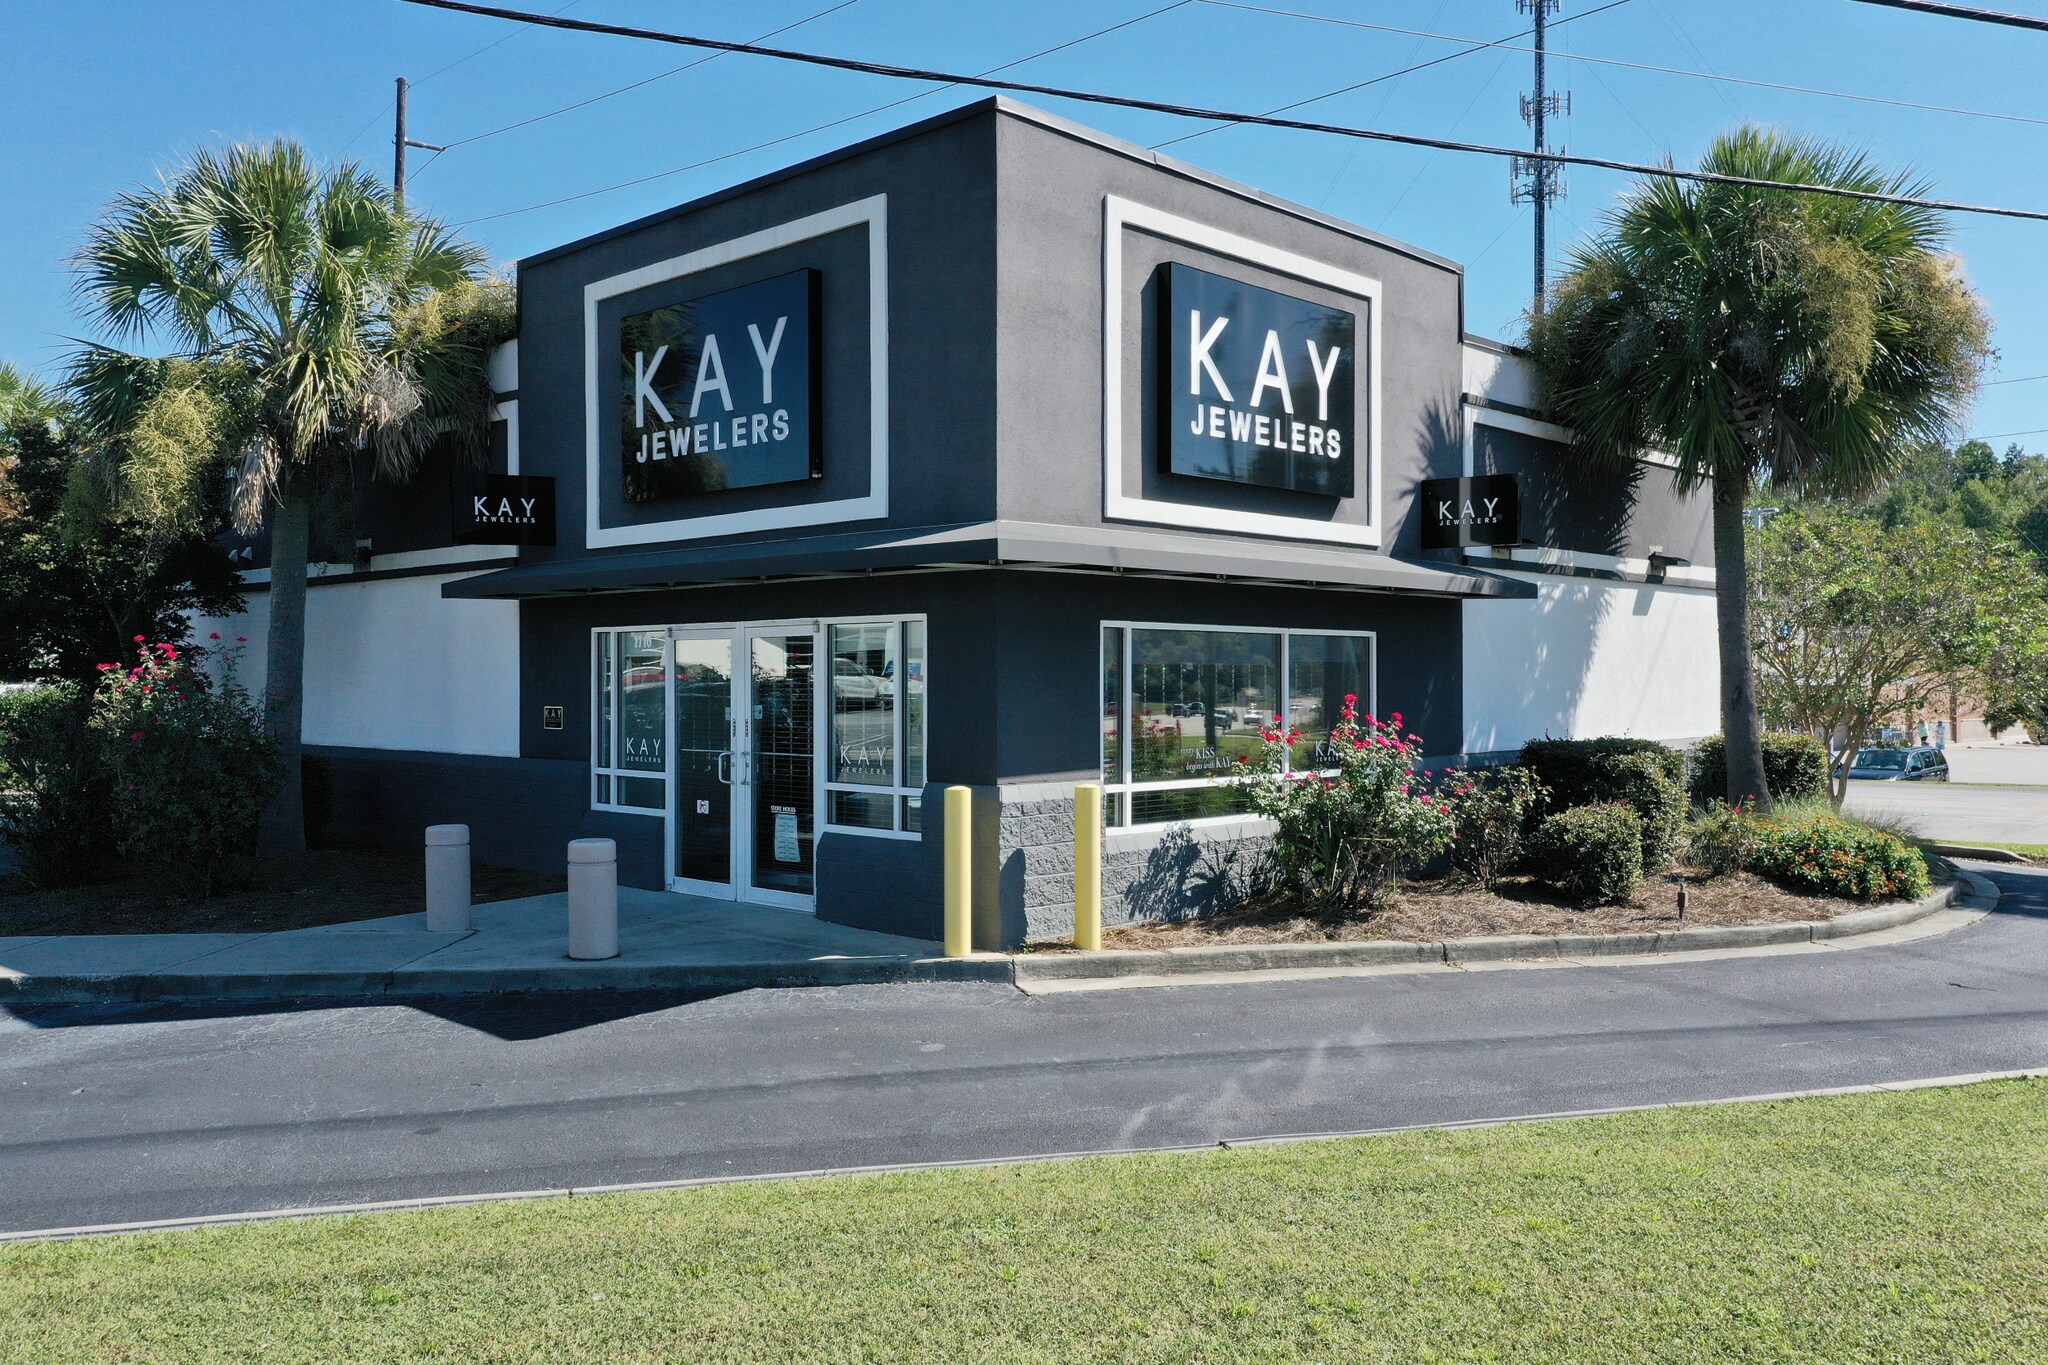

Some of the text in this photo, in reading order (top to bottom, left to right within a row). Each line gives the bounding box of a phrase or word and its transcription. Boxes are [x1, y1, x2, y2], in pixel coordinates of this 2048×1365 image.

[635, 315, 788, 428] KAY
[1190, 309, 1341, 421] KAY
[636, 408, 790, 463] JEWELERS
[1191, 404, 1341, 459] JEWELERS
[474, 496, 535, 517] KAY
[1439, 498, 1498, 520] KAY
[1439, 517, 1497, 526] JEWELERS
[626, 737, 660, 756] KAY
[840, 745, 886, 766] KAY
[1195, 747, 1215, 760] KISS
[1315, 740, 1335, 756] KA
[840, 767, 886, 775] JEWELERS
[1216, 756, 1232, 768] KAY
